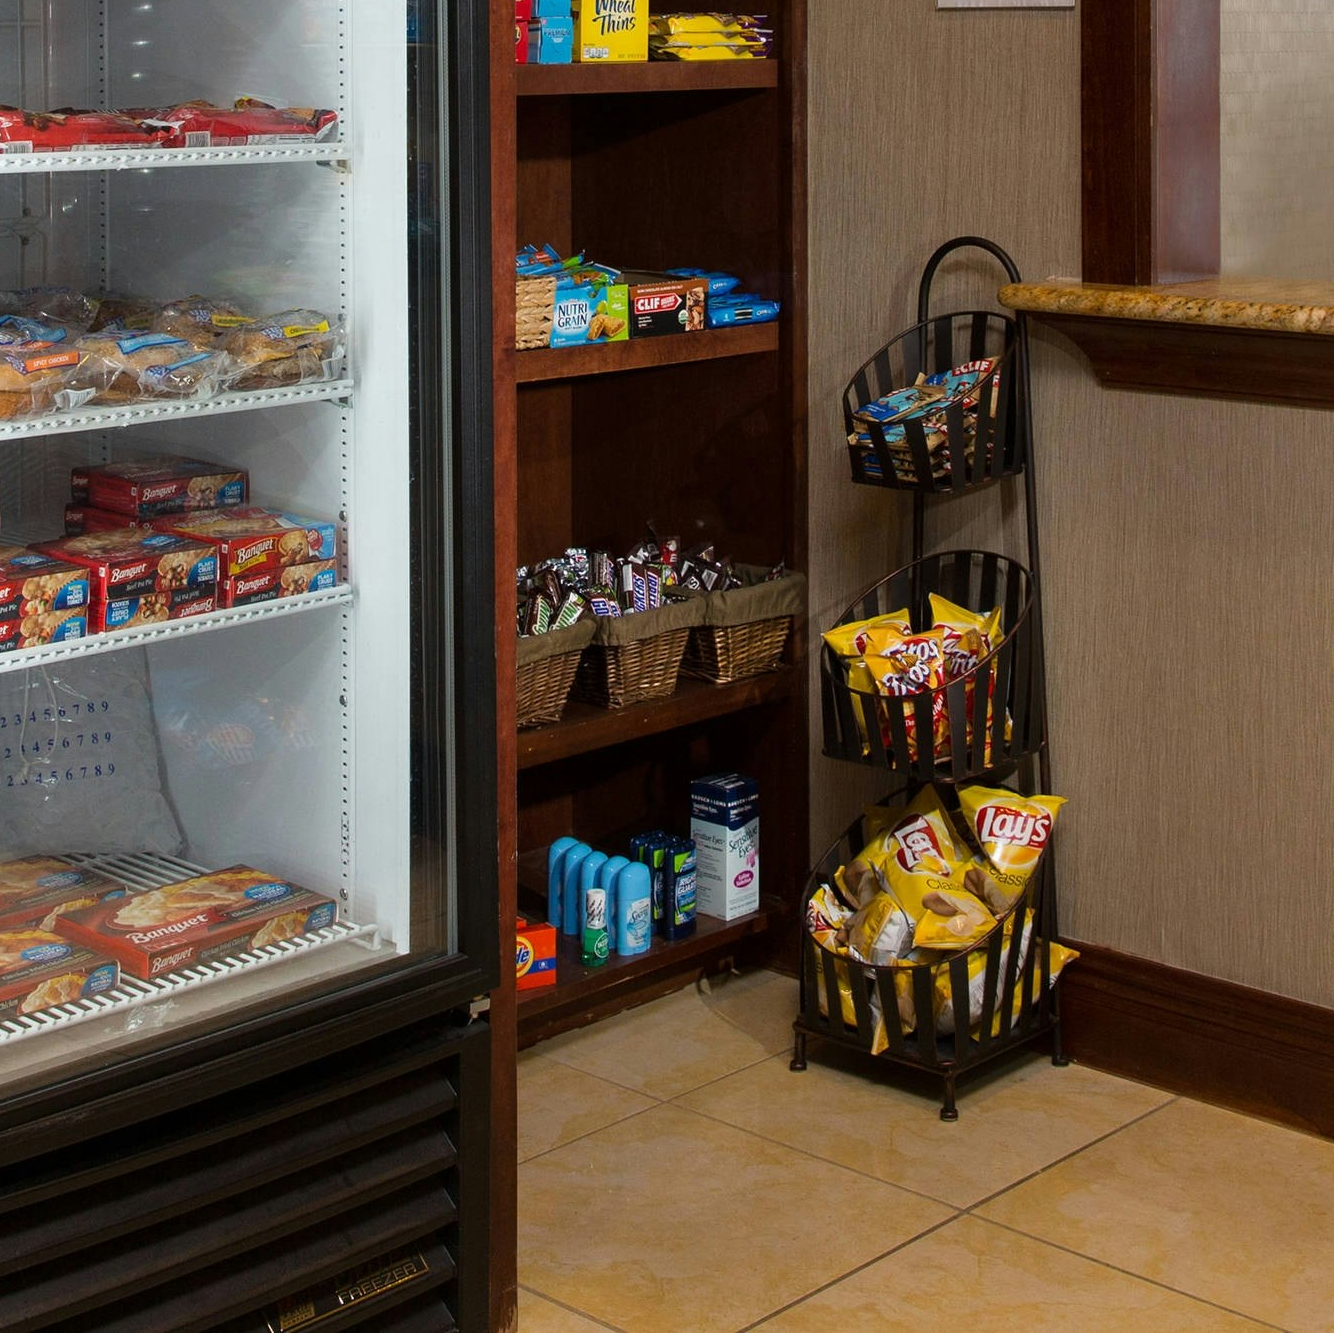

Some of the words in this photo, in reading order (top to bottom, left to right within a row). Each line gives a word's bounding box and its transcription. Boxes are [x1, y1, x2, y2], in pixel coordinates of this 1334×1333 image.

[543, 28, 571, 37] PREMIUM
[592, 16, 637, 36] Thins
[558, 303, 588, 318] NUTRI
[637, 296, 660, 311] CLIF
[557, 314, 587, 329] GRAIN
[960, 360, 990, 374] CLIF
[142, 483, 177, 500] Banquet
[237, 538, 274, 564] Banquet
[111, 563, 148, 583] Banquet
[198, 560, 215, 569] FLAKY
[236, 576, 271, 594] Banquet
[0, 604, 8, 614] Pot
[179, 597, 214, 618] Banquet
[980, 807, 1051, 847] Lay's
[729, 825, 758, 853] Sensitive
[127, 912, 209, 944] Banquet
[152, 946, 194, 973] Banquet
[338, 1261, 418, 1305] FREEZER
